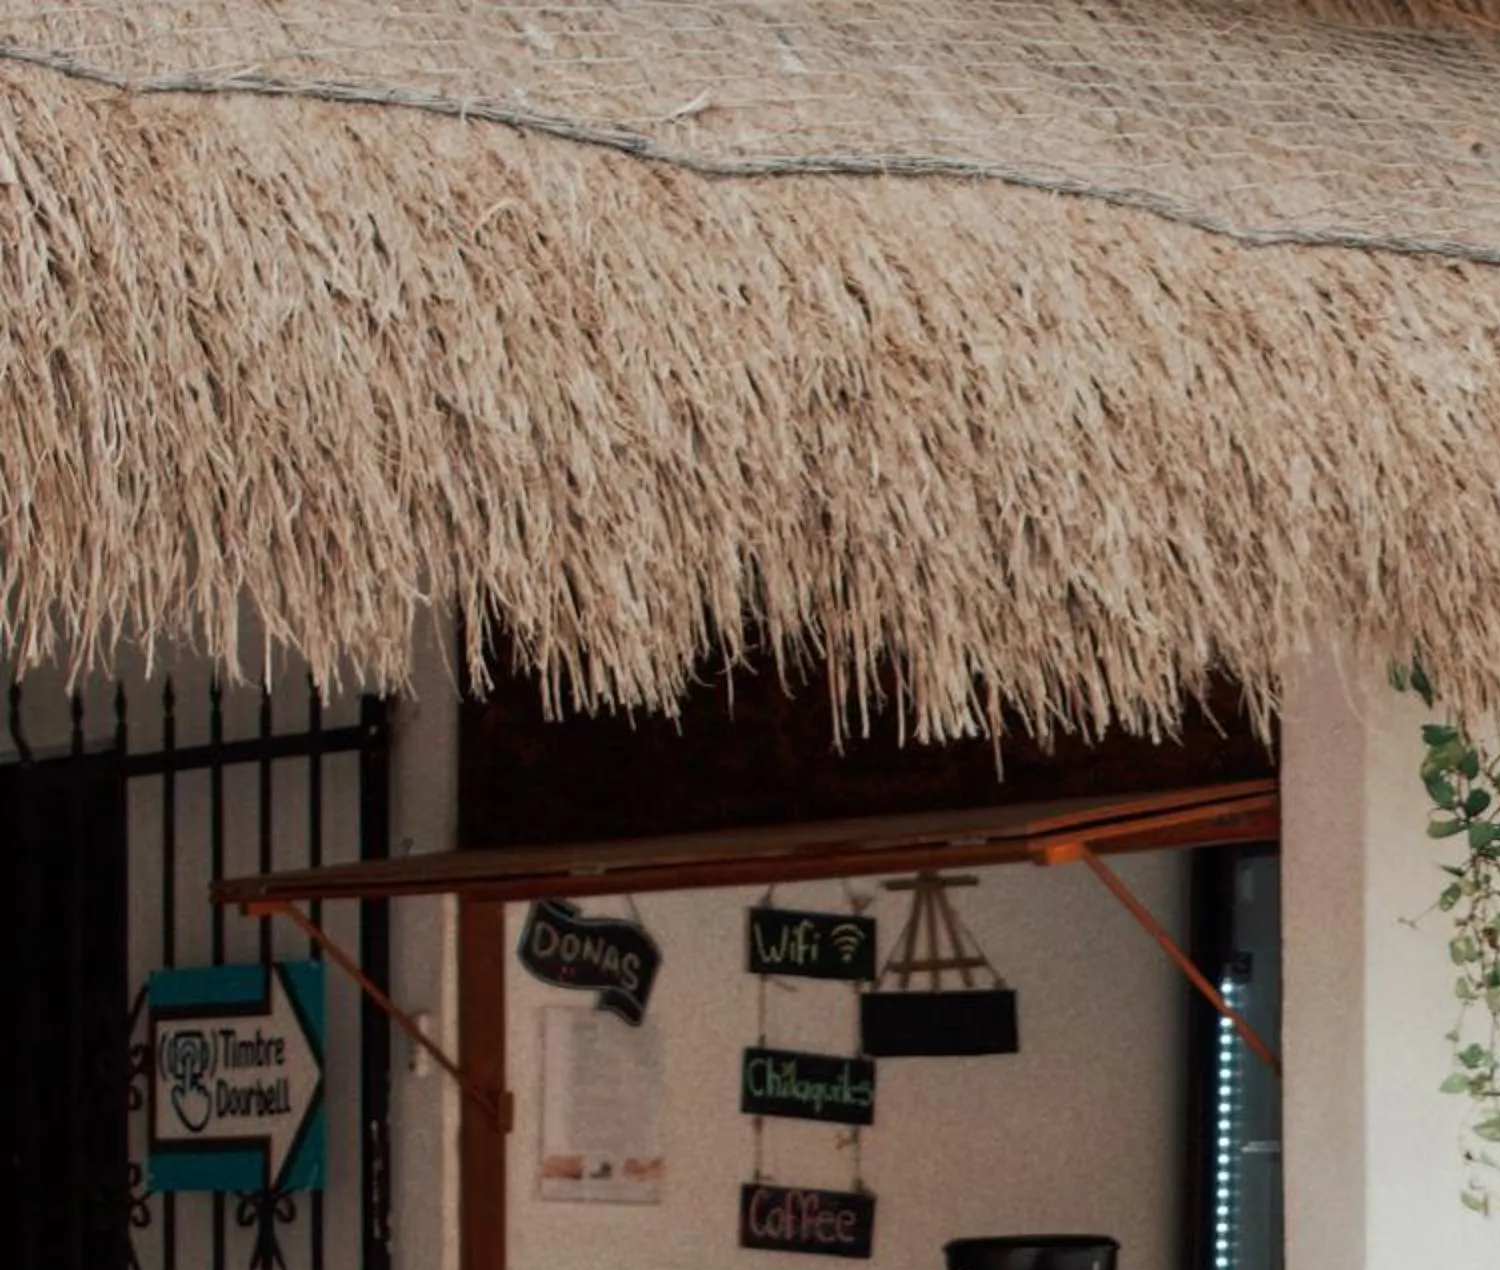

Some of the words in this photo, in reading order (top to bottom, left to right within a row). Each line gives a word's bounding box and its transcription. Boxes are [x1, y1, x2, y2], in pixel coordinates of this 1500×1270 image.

[533, 920, 641, 992] DONAS
[219, 1027, 286, 1069] Timbre
[216, 1079, 291, 1118] Doorbell
[750, 1189, 857, 1243] Coffee
